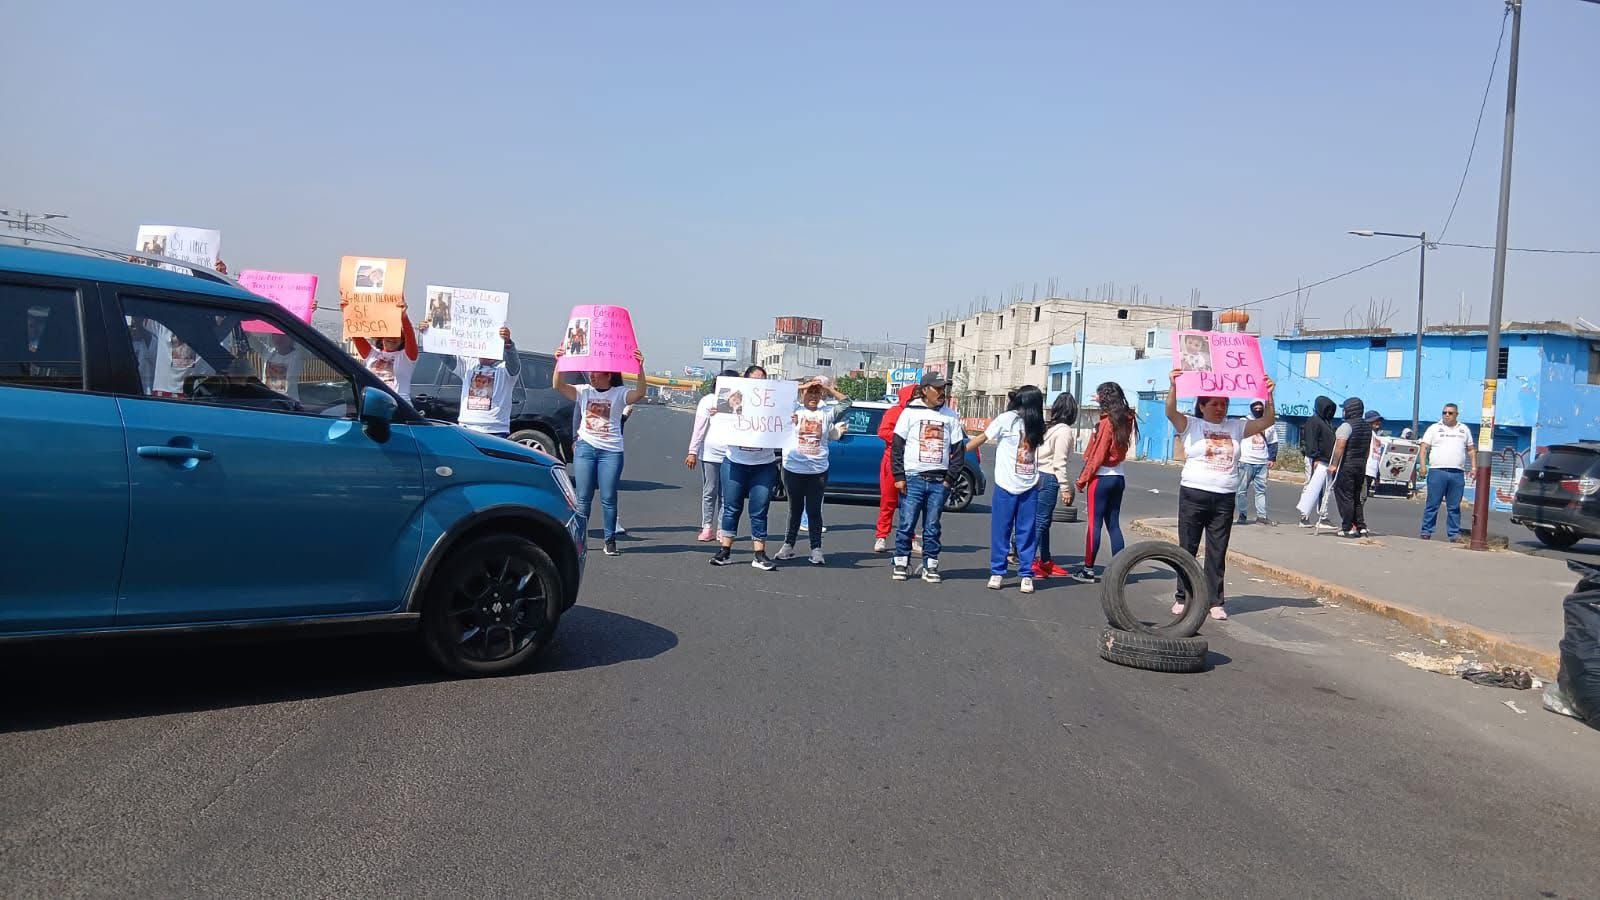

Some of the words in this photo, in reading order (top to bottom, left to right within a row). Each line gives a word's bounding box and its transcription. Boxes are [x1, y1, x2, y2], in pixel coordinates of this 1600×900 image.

[346, 318, 388, 334] BUSCA
[1225, 351, 1248, 368] SE
[1200, 372, 1257, 391] BUSCA
[752, 387, 776, 407] SE
[735, 415, 783, 432] BUSCA
